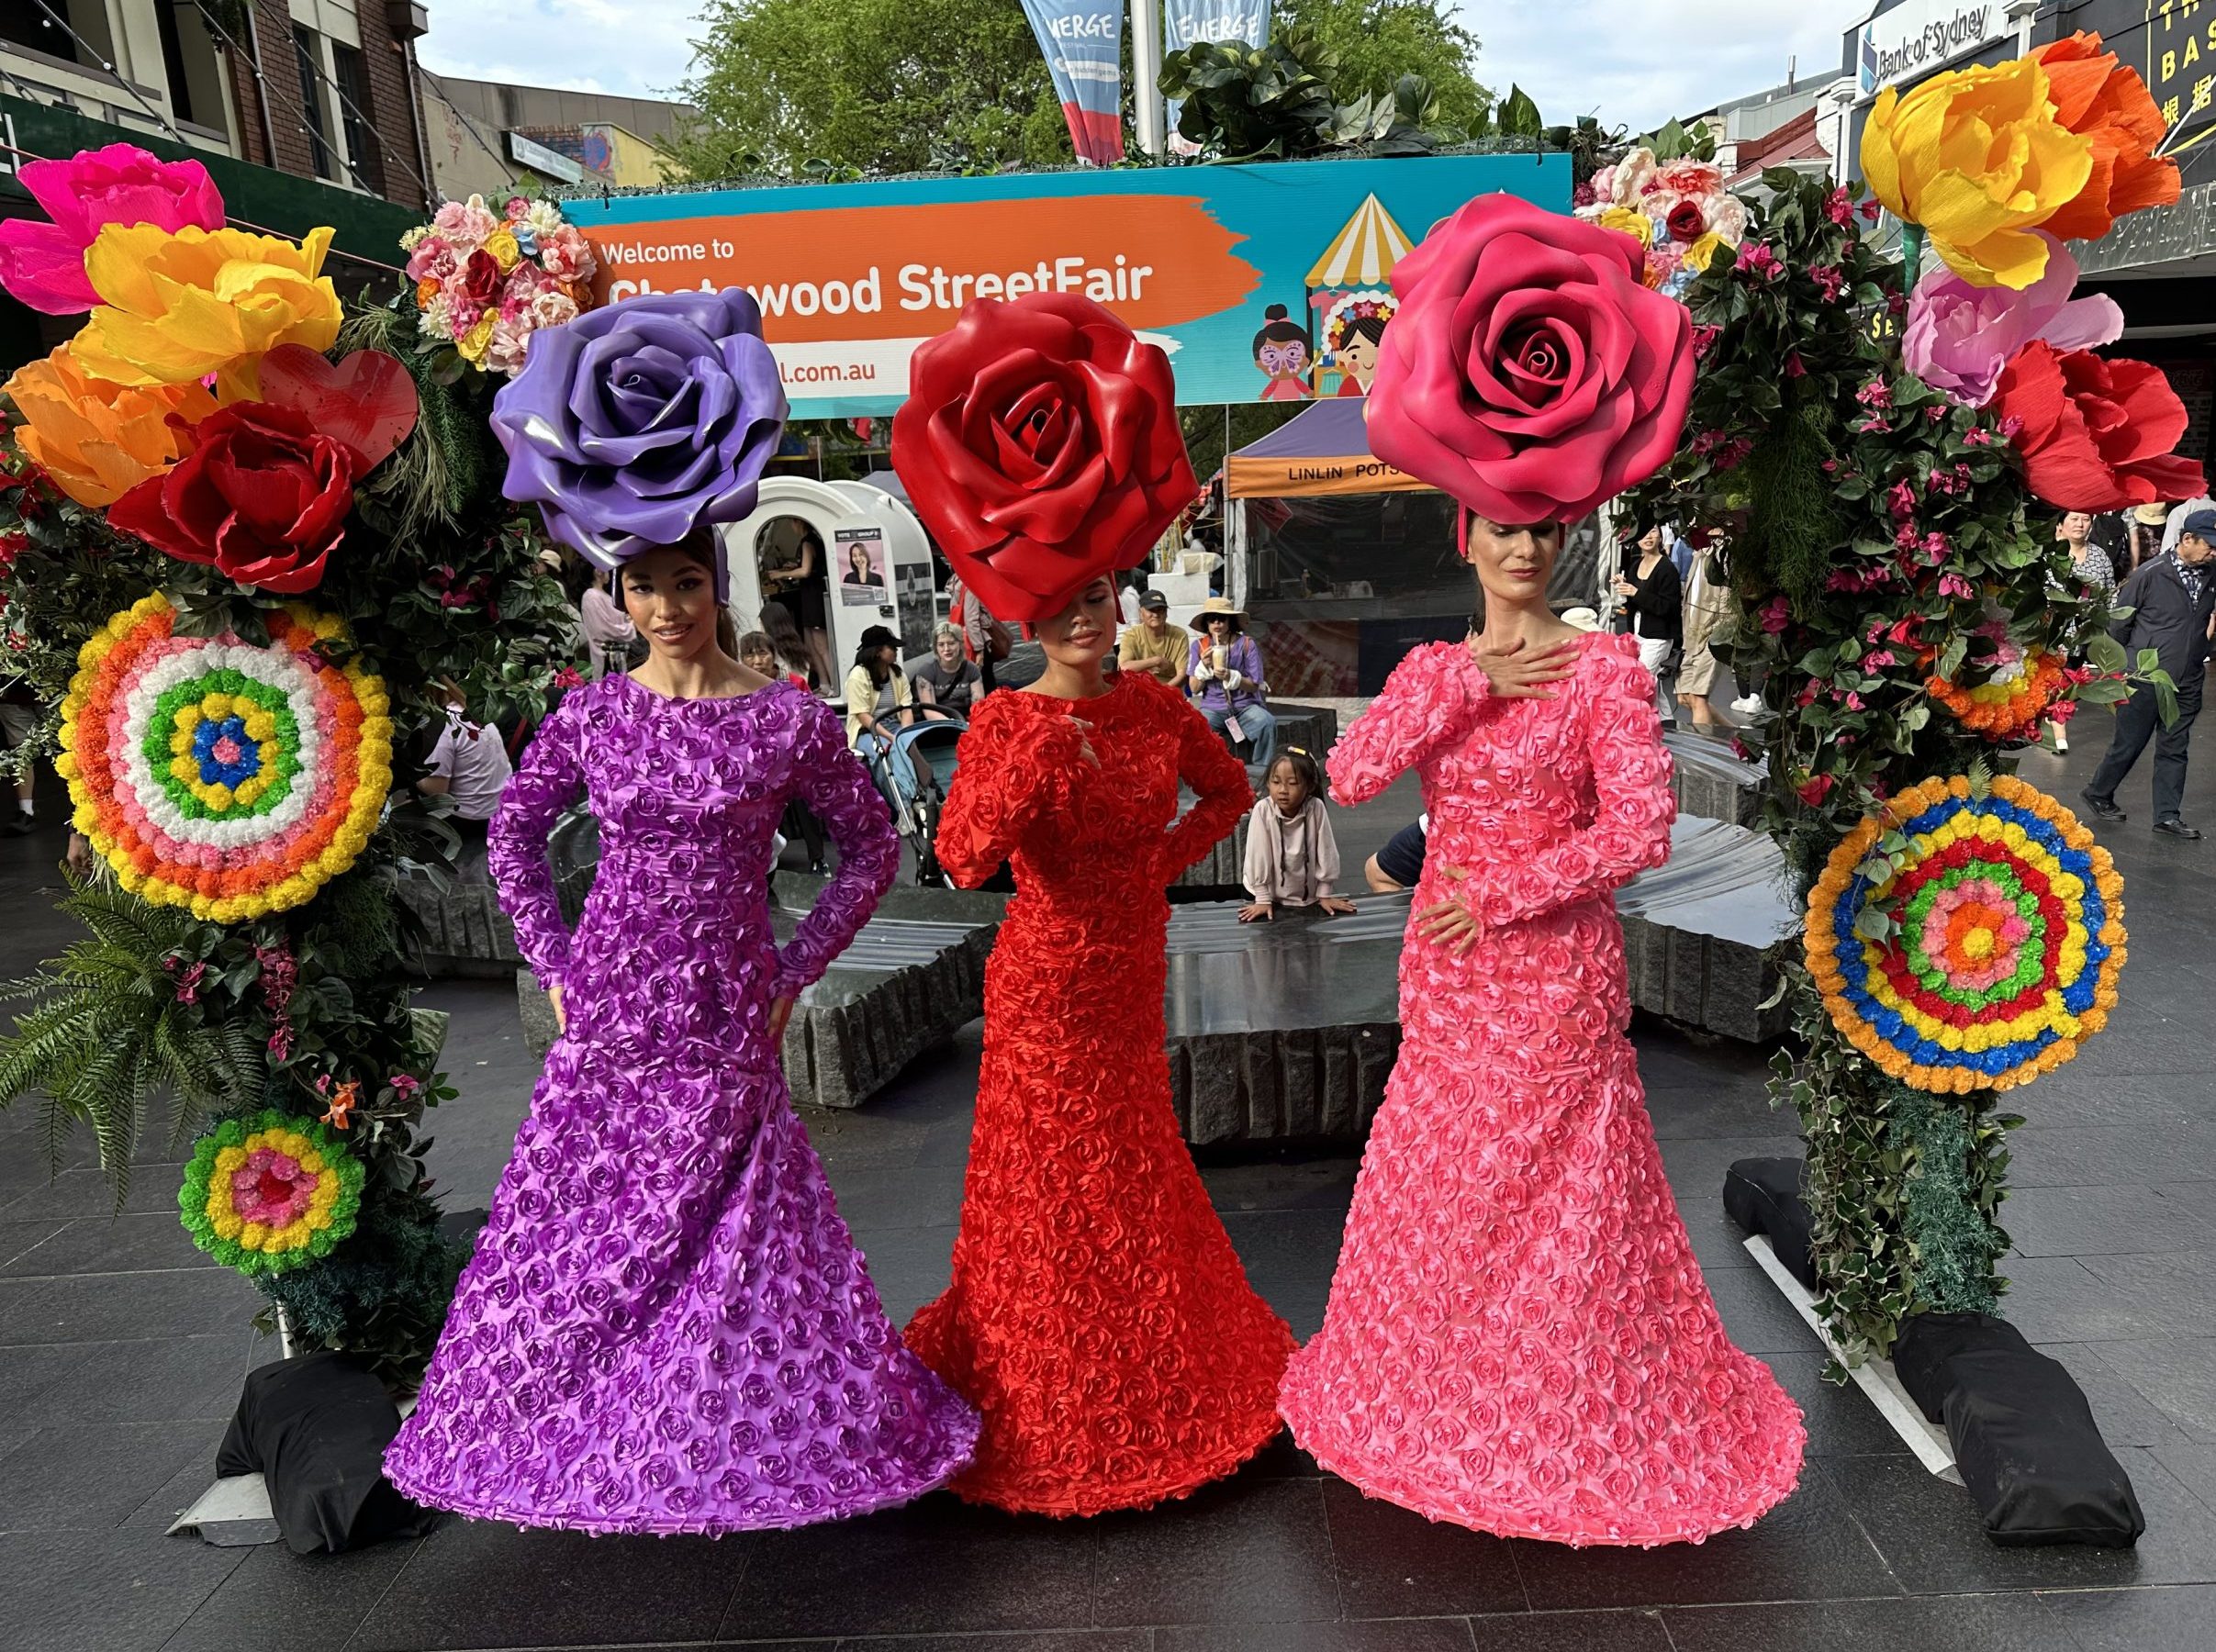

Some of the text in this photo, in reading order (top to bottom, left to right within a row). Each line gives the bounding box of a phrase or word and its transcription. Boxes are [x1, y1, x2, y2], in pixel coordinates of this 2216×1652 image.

[1176, 13, 1259, 42] EMERGE
[1879, 5, 1989, 79] Bank of Sydney
[601, 239, 734, 264] Welcome to
[899, 254, 1153, 310] StreetFair
[1289, 466, 1343, 480] LINLIN
